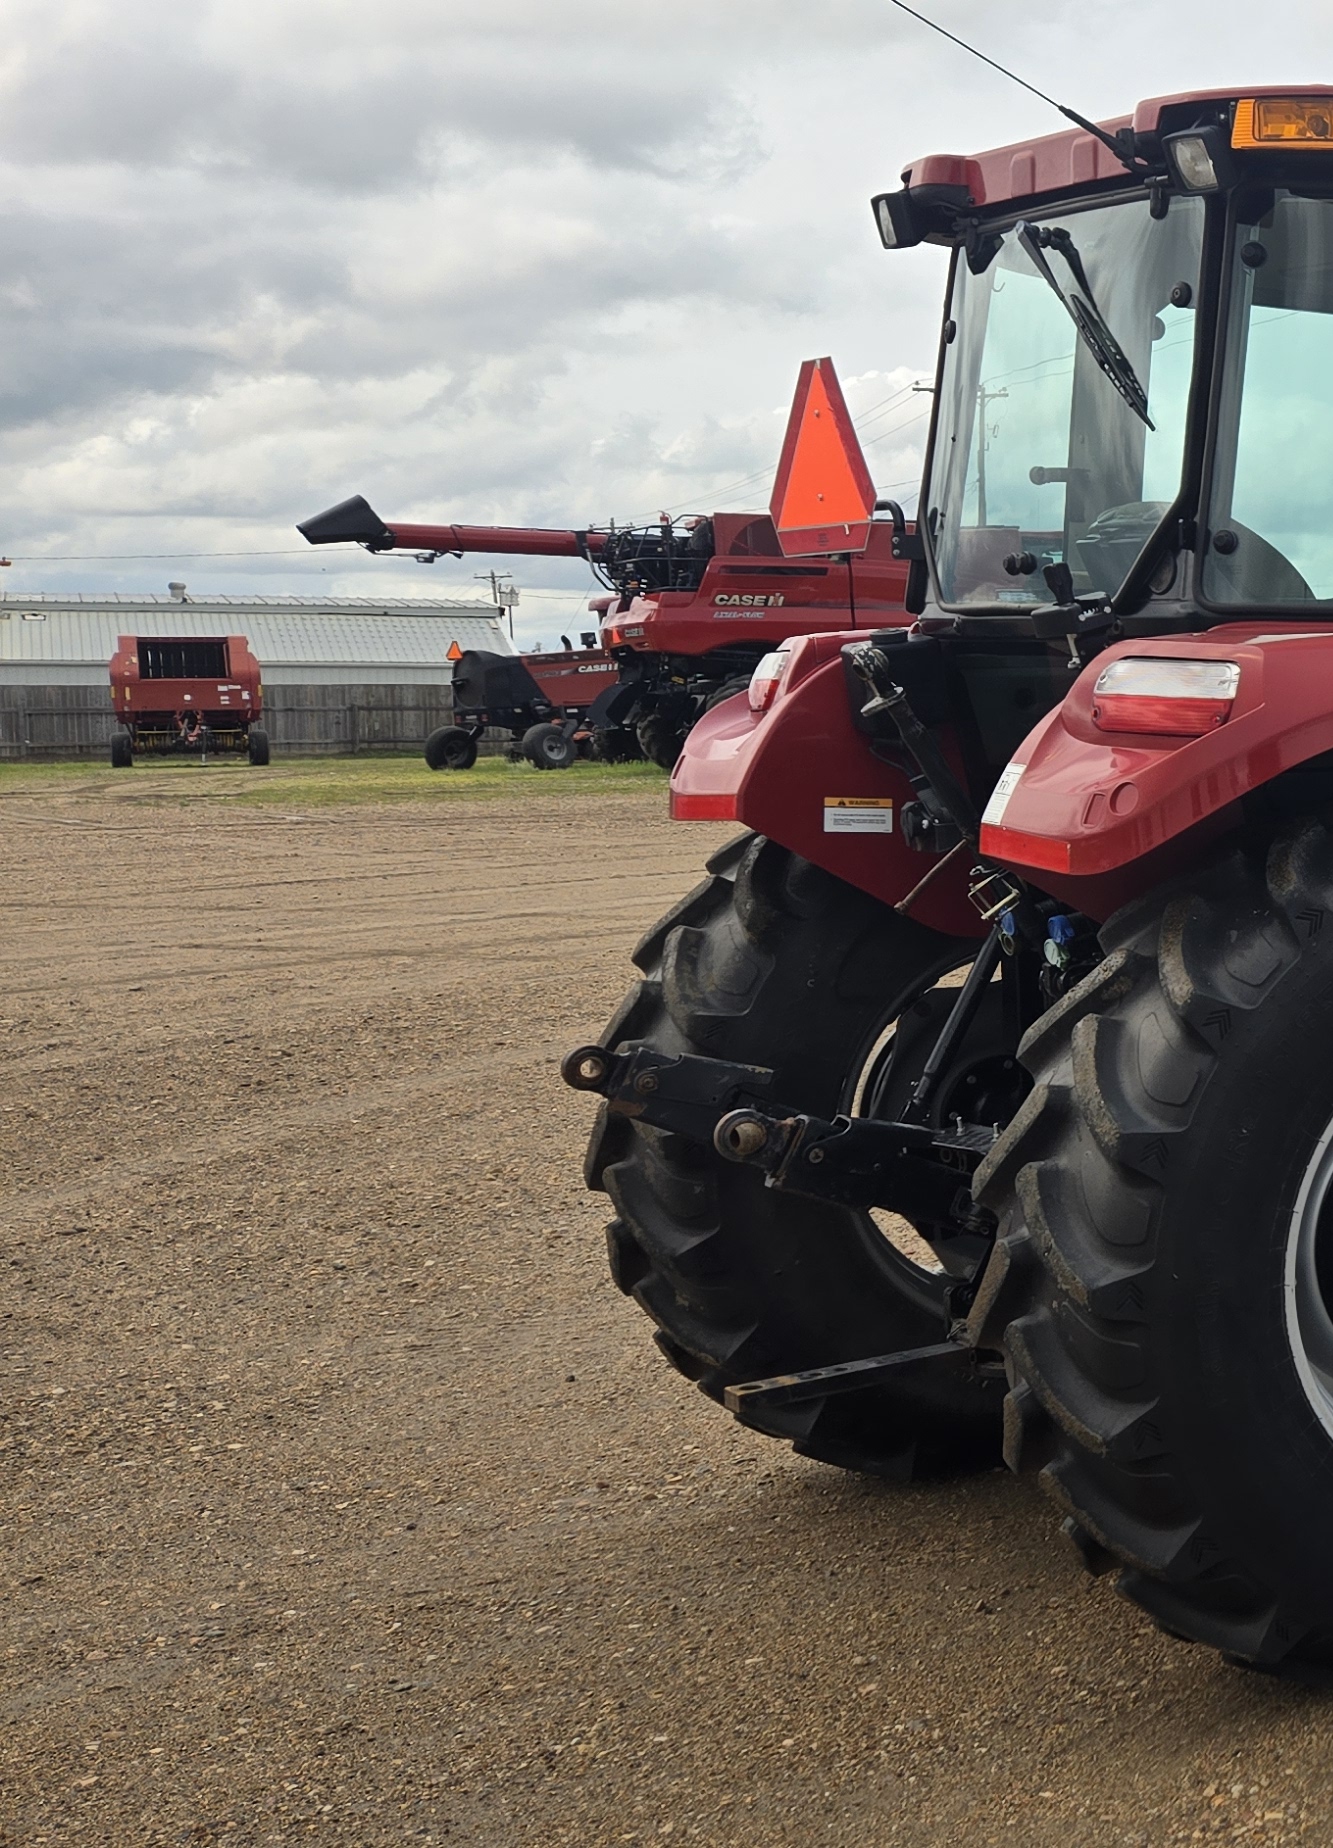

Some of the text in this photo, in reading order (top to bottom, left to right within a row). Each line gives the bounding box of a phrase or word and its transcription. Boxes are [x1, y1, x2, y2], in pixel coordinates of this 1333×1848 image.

[714, 592, 785, 607] CASE IH
[578, 663, 608, 673] CASE
